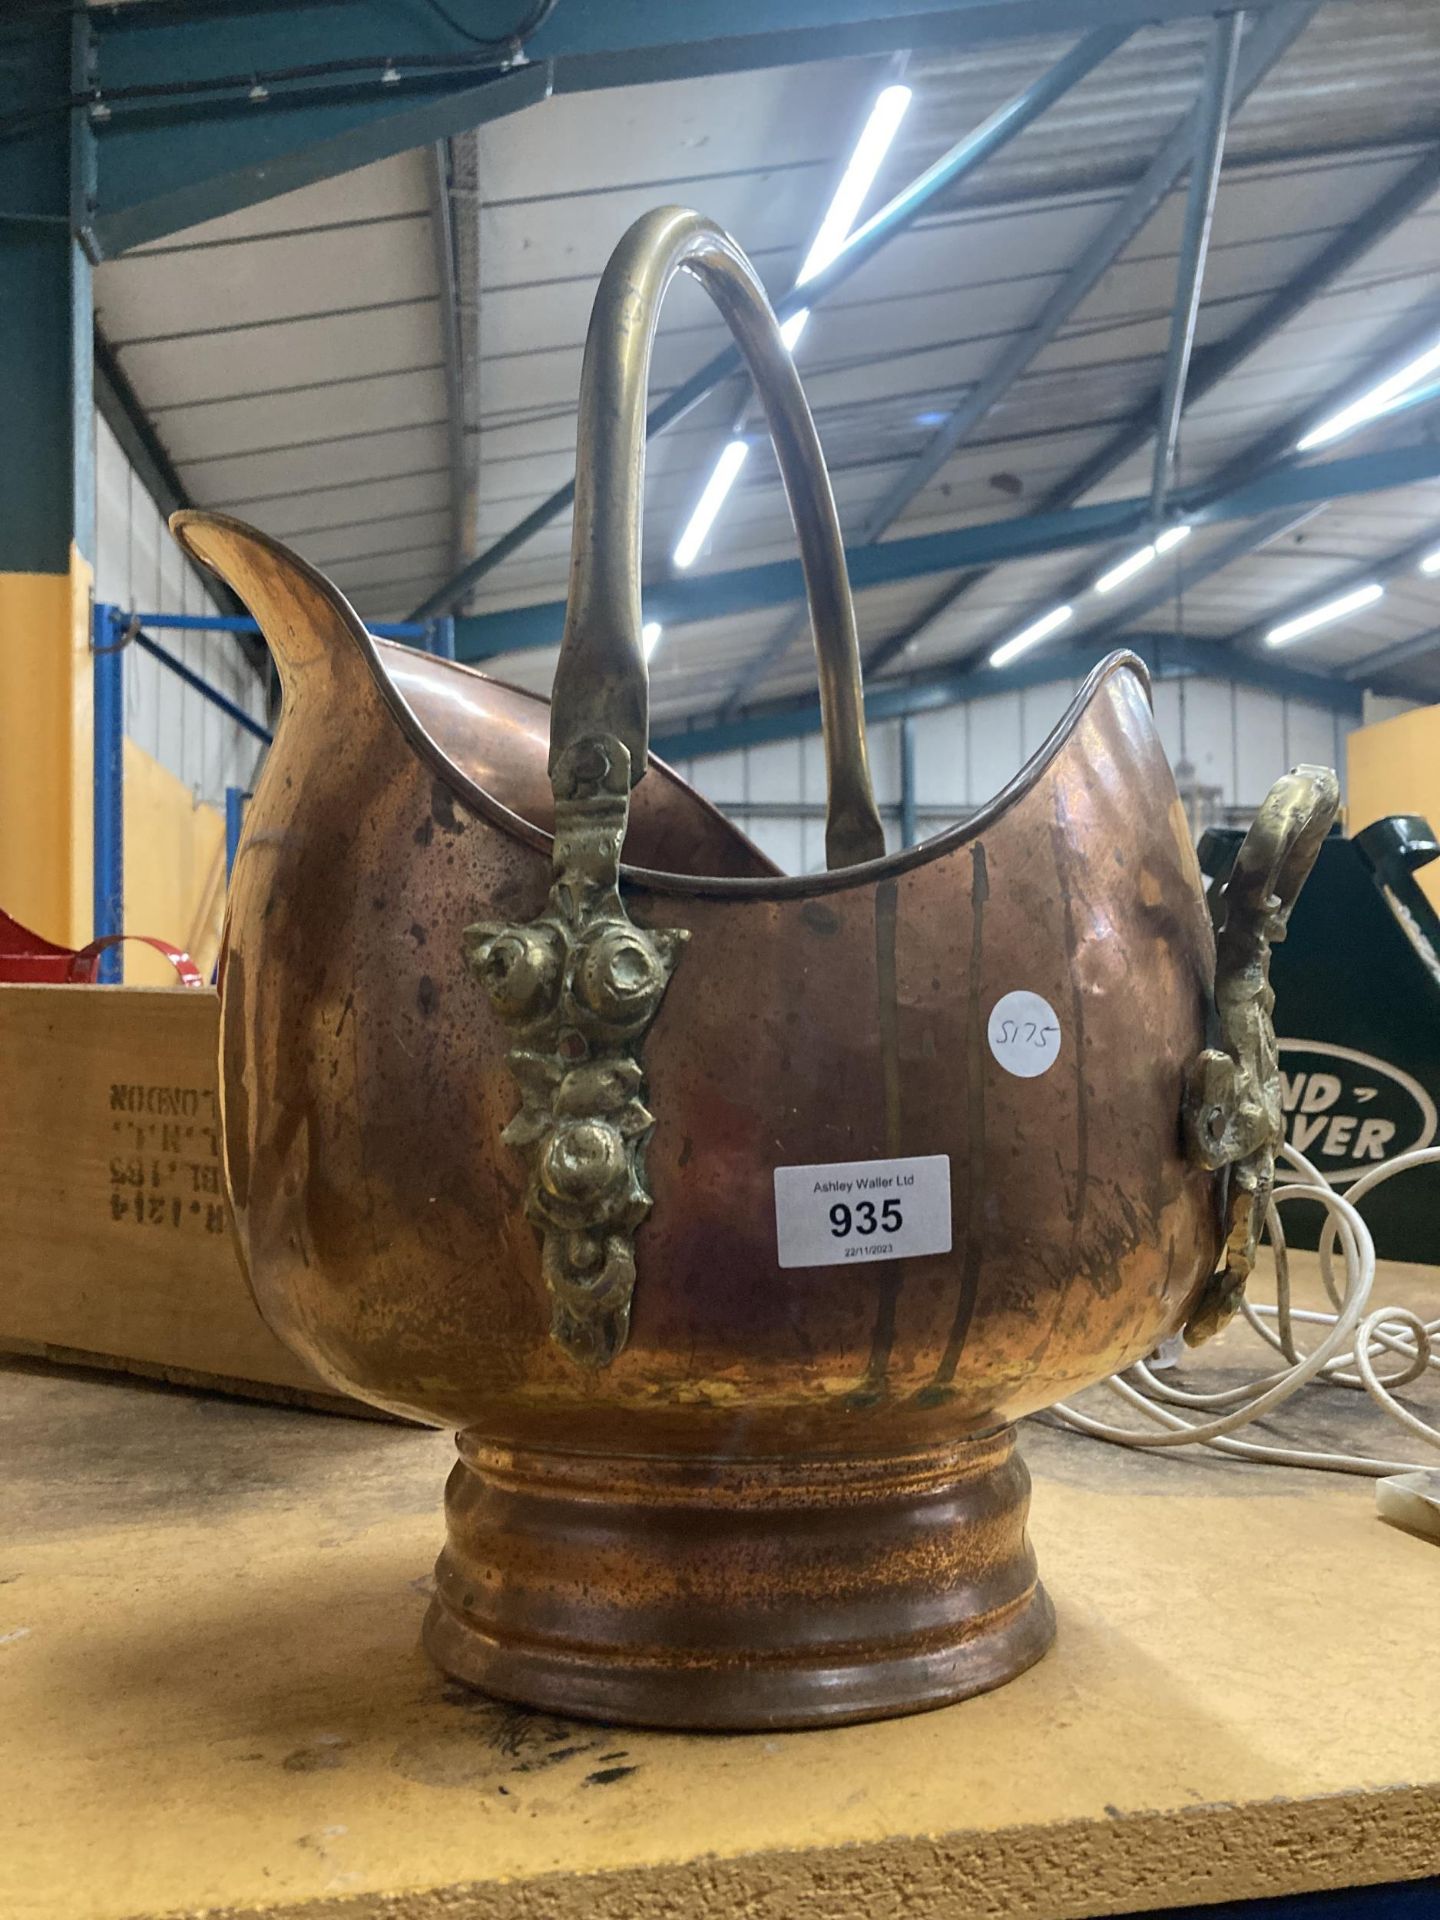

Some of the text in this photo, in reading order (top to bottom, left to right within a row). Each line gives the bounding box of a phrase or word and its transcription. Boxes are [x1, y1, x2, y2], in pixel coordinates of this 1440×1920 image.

[1278, 1071, 1342, 1113] ND
[1282, 1112, 1396, 1159] VER
[813, 1174, 914, 1194] Ashley Waller Ltd
[829, 1198, 903, 1238] 935
[844, 1243, 893, 1258] 22/11/2023
